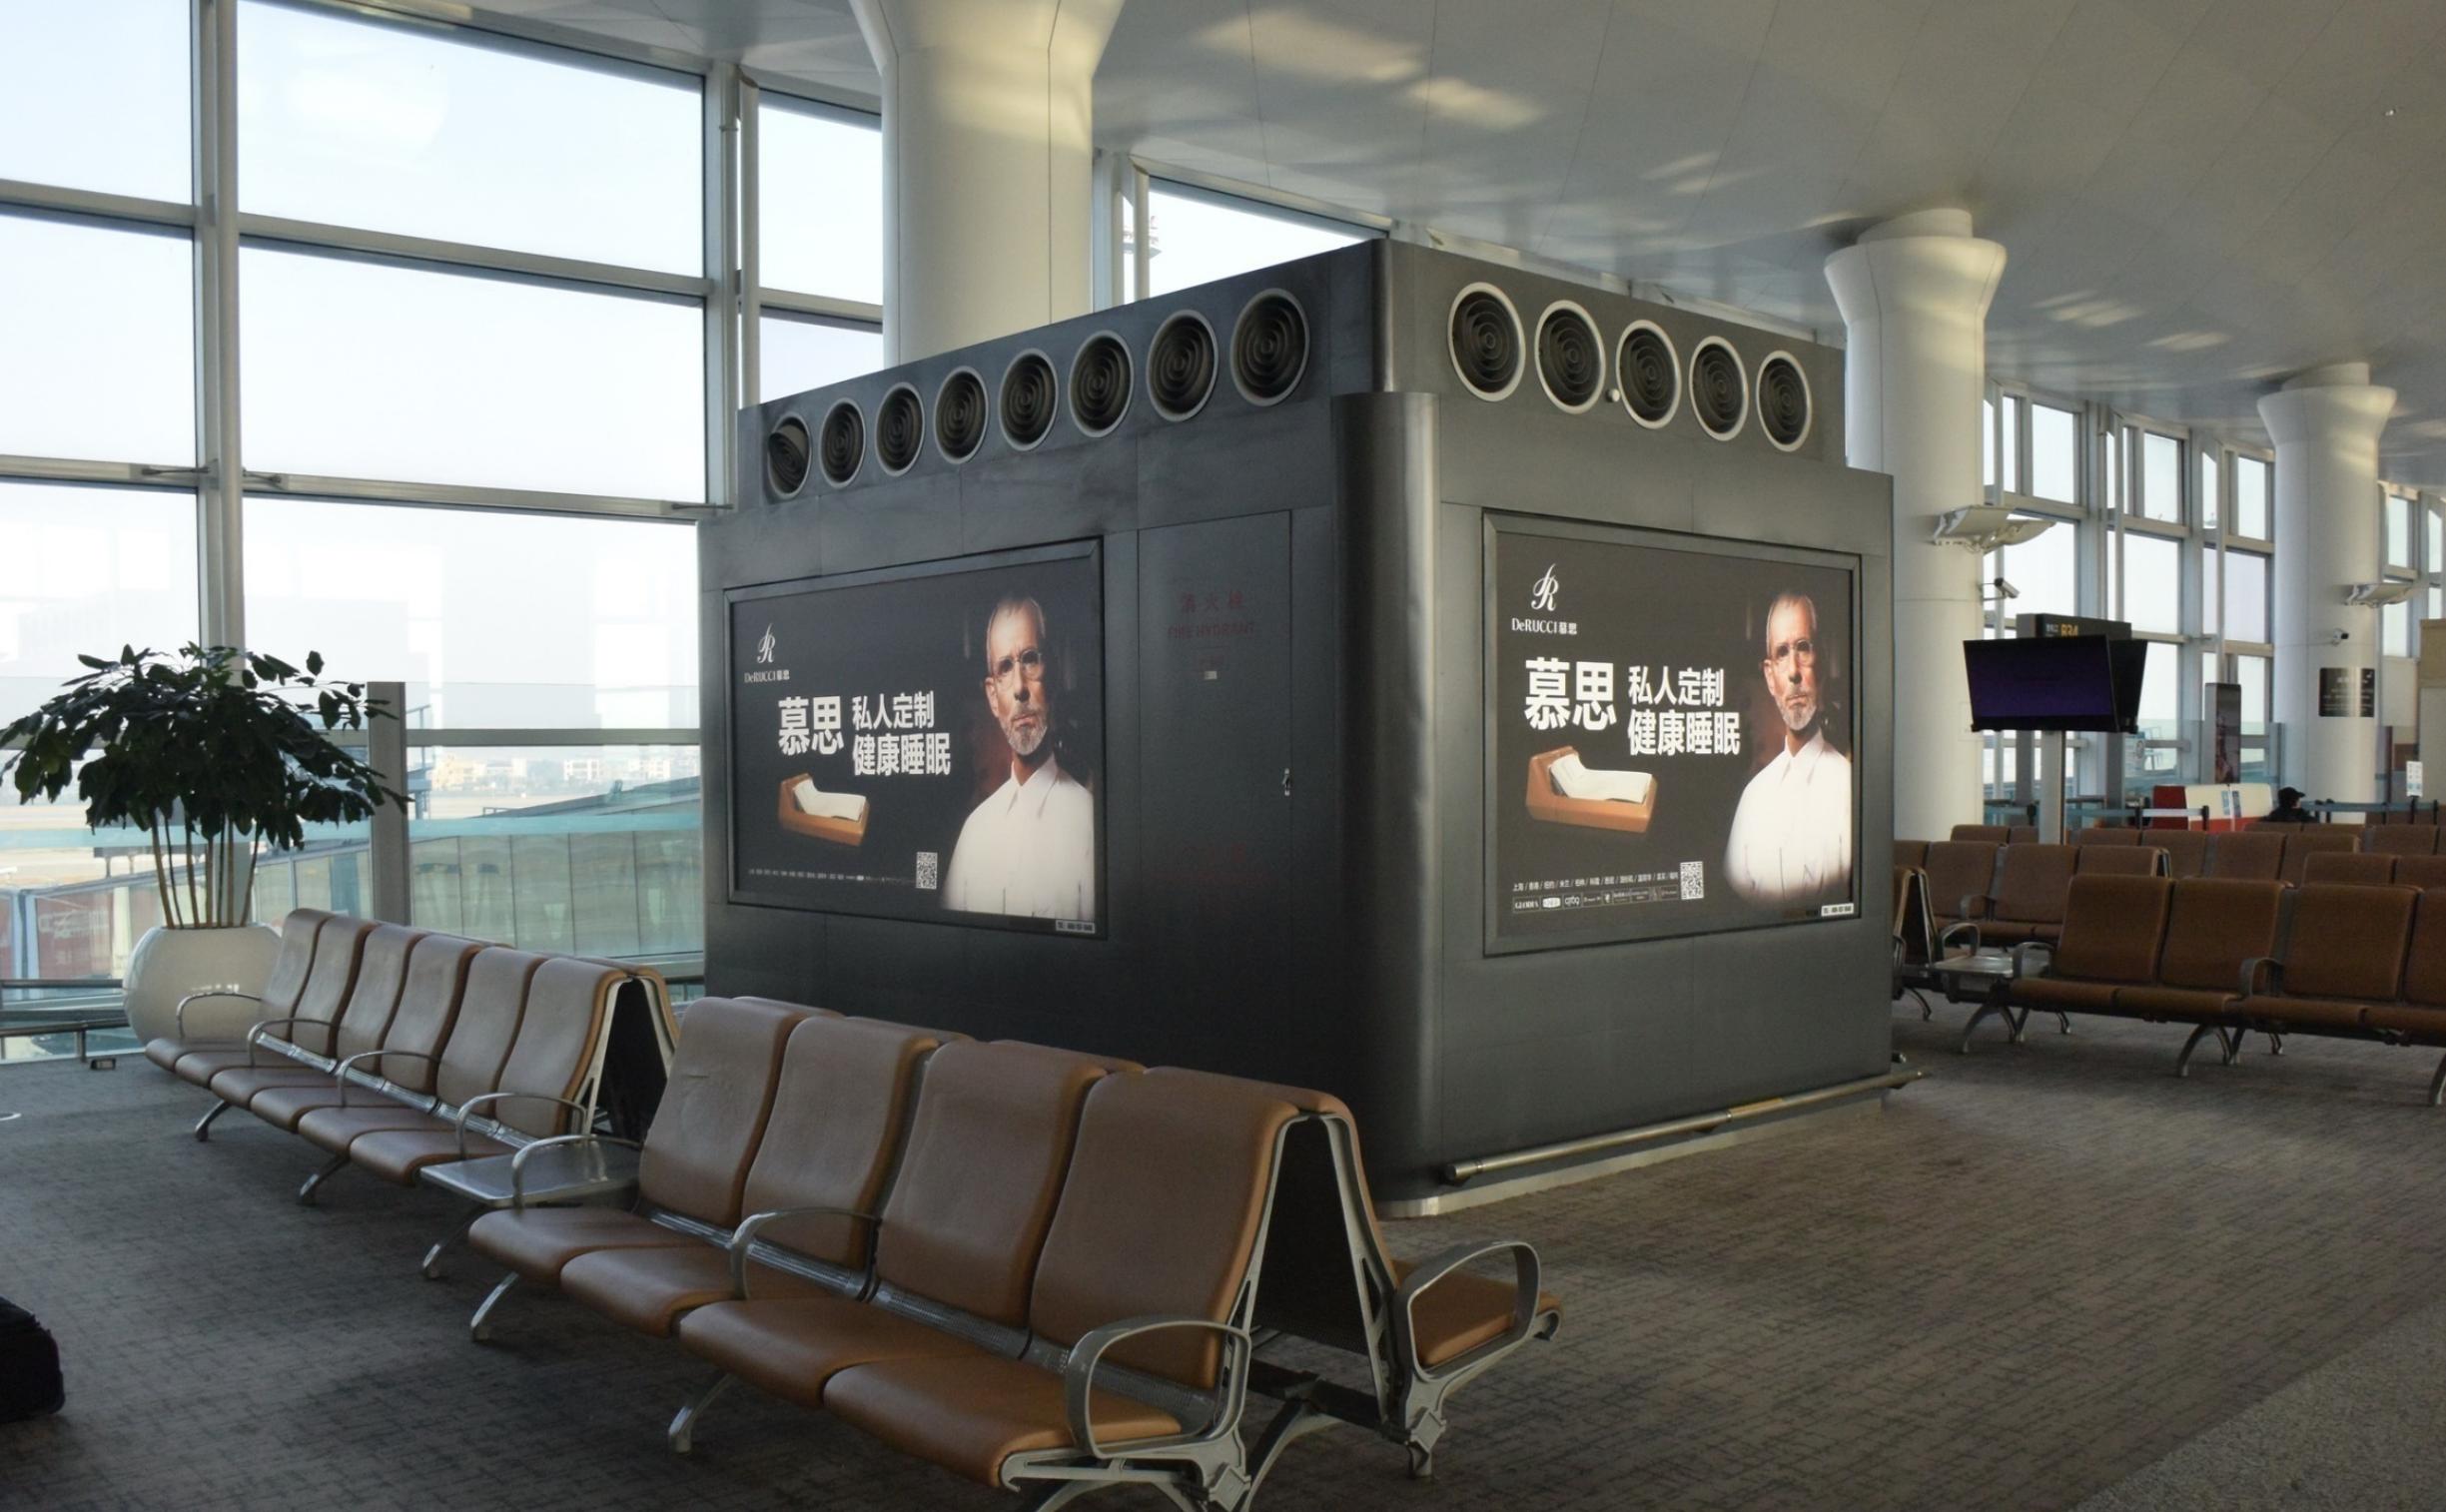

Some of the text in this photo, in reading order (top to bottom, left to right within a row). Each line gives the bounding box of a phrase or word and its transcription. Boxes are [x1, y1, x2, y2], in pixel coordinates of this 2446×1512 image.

[1511, 617, 1557, 634] DeRUCCI
[1524, 656, 1617, 731] 慕思
[1628, 665, 1725, 707] 私人定制
[778, 696, 844, 756] 慕思
[852, 690, 935, 730] 私人定制
[1627, 708, 1741, 756] 健康睡眠
[852, 732, 951, 776] 健康睡眠
